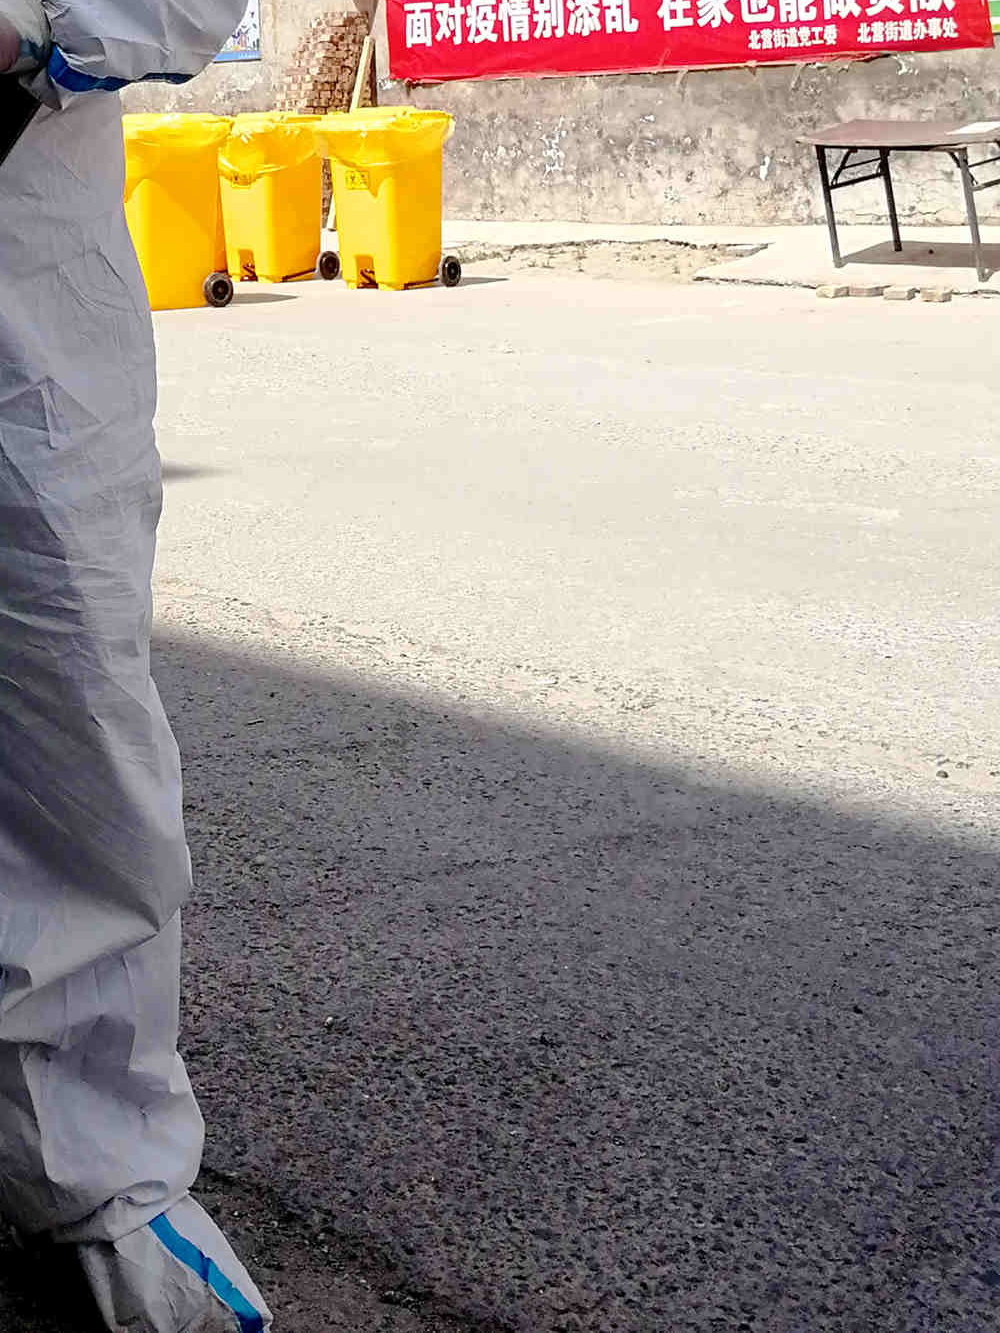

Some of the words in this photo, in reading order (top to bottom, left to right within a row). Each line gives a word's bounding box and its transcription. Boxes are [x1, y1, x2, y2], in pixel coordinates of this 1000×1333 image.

[748, 24, 837, 50] 北营街道党工委
[857, 16, 959, 44] 北营街道办事处
